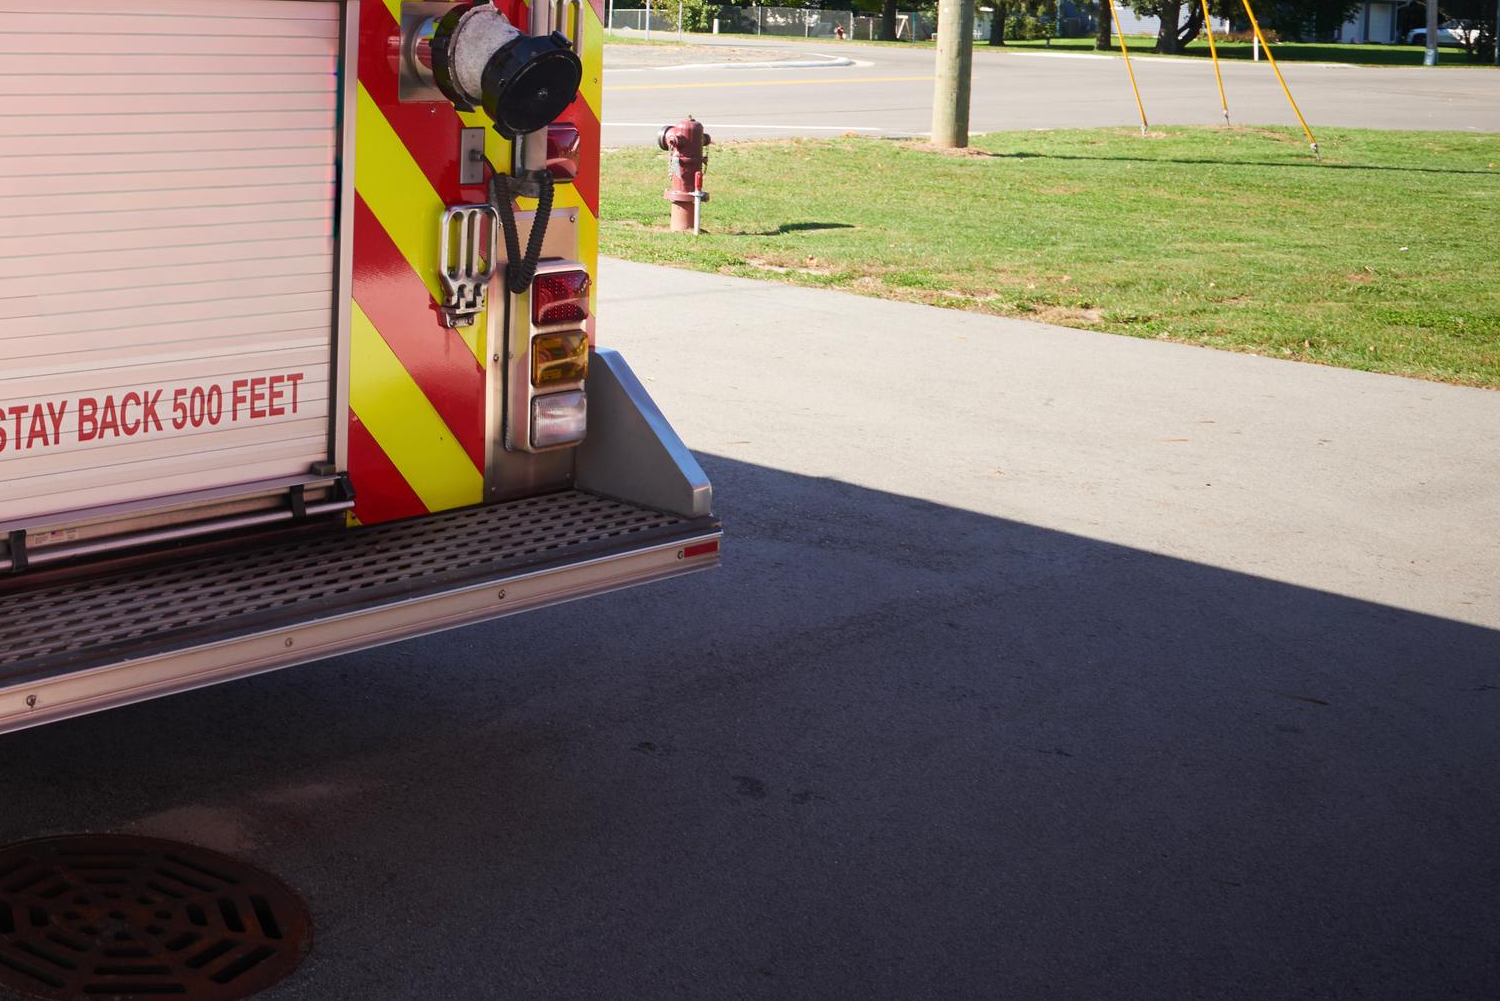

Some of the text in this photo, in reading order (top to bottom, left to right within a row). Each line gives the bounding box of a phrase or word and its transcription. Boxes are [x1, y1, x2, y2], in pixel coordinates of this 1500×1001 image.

[77, 390, 164, 443] BACK
[172, 384, 223, 430] 500
[232, 373, 304, 423] FEET
